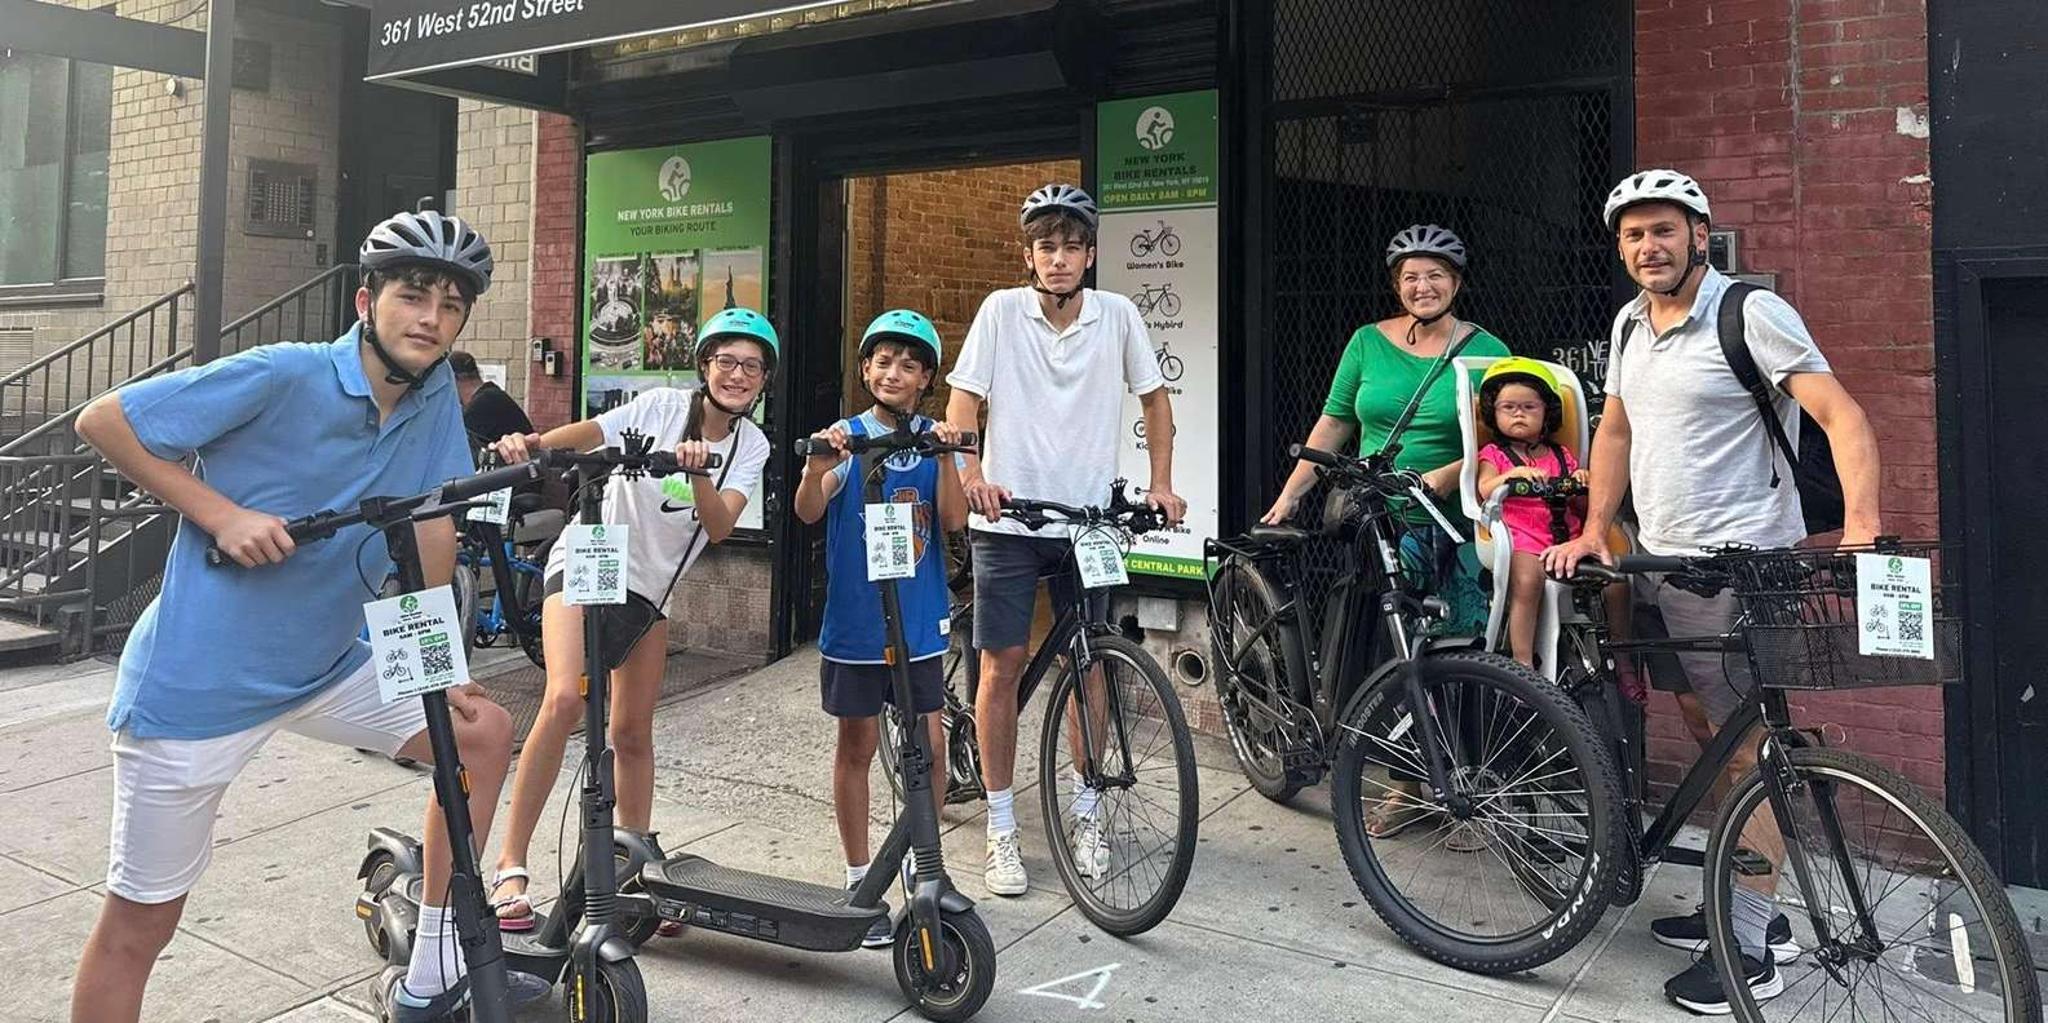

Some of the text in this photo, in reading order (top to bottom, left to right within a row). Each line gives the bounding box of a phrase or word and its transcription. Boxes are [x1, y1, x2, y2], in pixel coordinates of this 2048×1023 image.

[381, 0, 584, 46] 361 West 52nd Street
[1125, 152, 1185, 166] NEW YORK
[1114, 165, 1197, 180] BIKE RENTALS
[1103, 192, 1129, 203] OPEN
[1130, 190, 1156, 202] DAILY
[618, 201, 733, 222] NEW YORK BIKE RENTALS
[630, 221, 716, 236] YOUR BIKING ROUTE
[1127, 260, 1184, 270] Women's Bike
[1552, 346, 1588, 373] 361
[1143, 535, 1170, 545] Online
[1131, 558, 1175, 573] CENTRAL
[1177, 564, 1204, 576] PARK
[1870, 583, 1921, 594] BIKE RENTAL
[383, 617, 445, 638] BIKE RENTAL
[1542, 850, 1600, 939] KENDA
